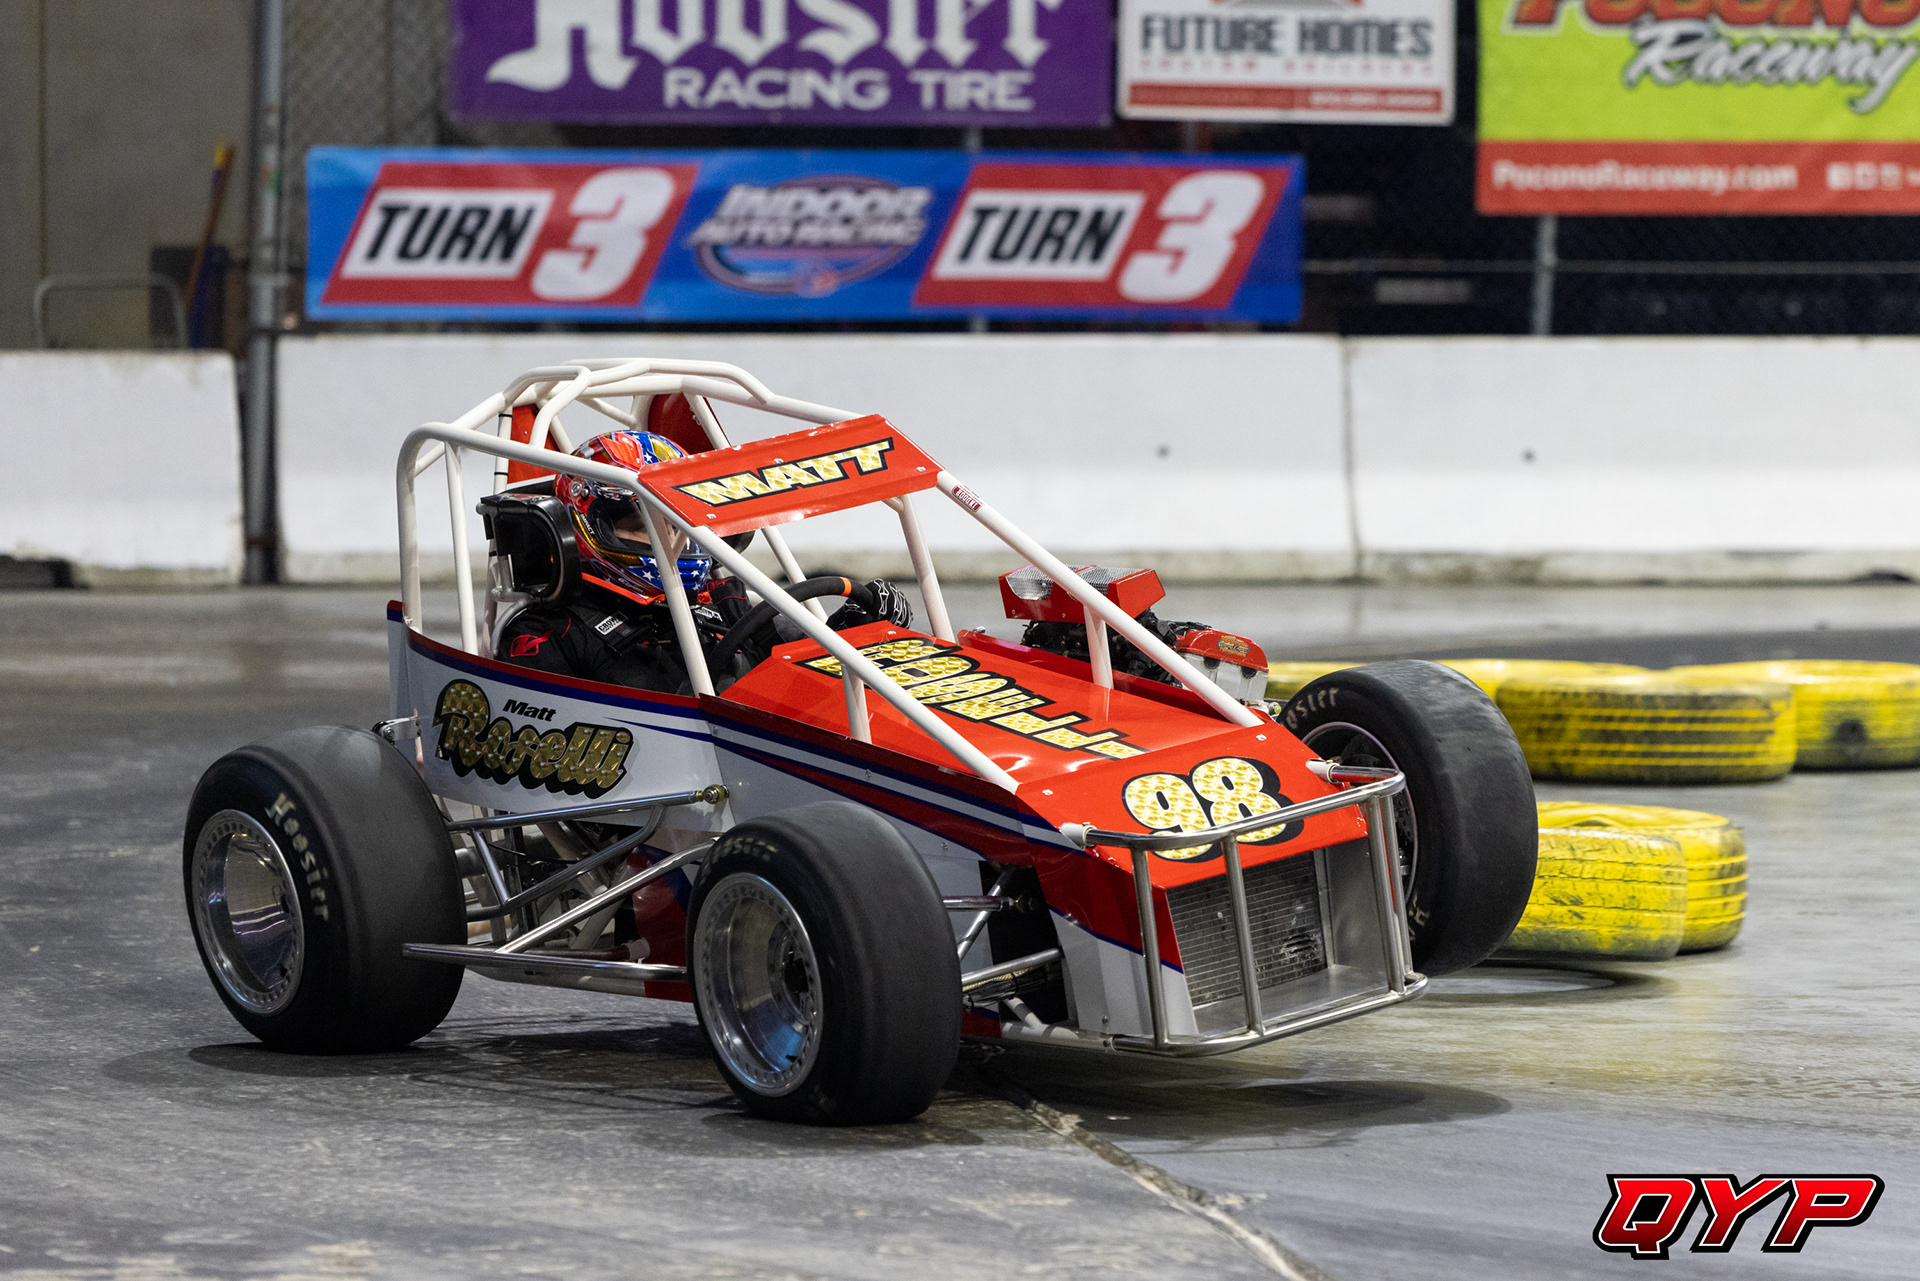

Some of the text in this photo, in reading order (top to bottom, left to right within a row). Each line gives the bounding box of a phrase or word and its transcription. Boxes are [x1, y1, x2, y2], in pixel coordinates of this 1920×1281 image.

[1140, 16, 1435, 59] FUTURE HOMES
[1622, 18, 1919, 115] Raceway
[662, 67, 1035, 111] RACING TIRE
[364, 167, 675, 301] TURN 3
[712, 184, 932, 221] INDOOR
[958, 170, 1265, 301] TURN 3
[671, 437, 894, 507] MATT
[432, 678, 634, 800] Roselli
[502, 698, 557, 722] Matt
[1121, 755, 1305, 864] 98
